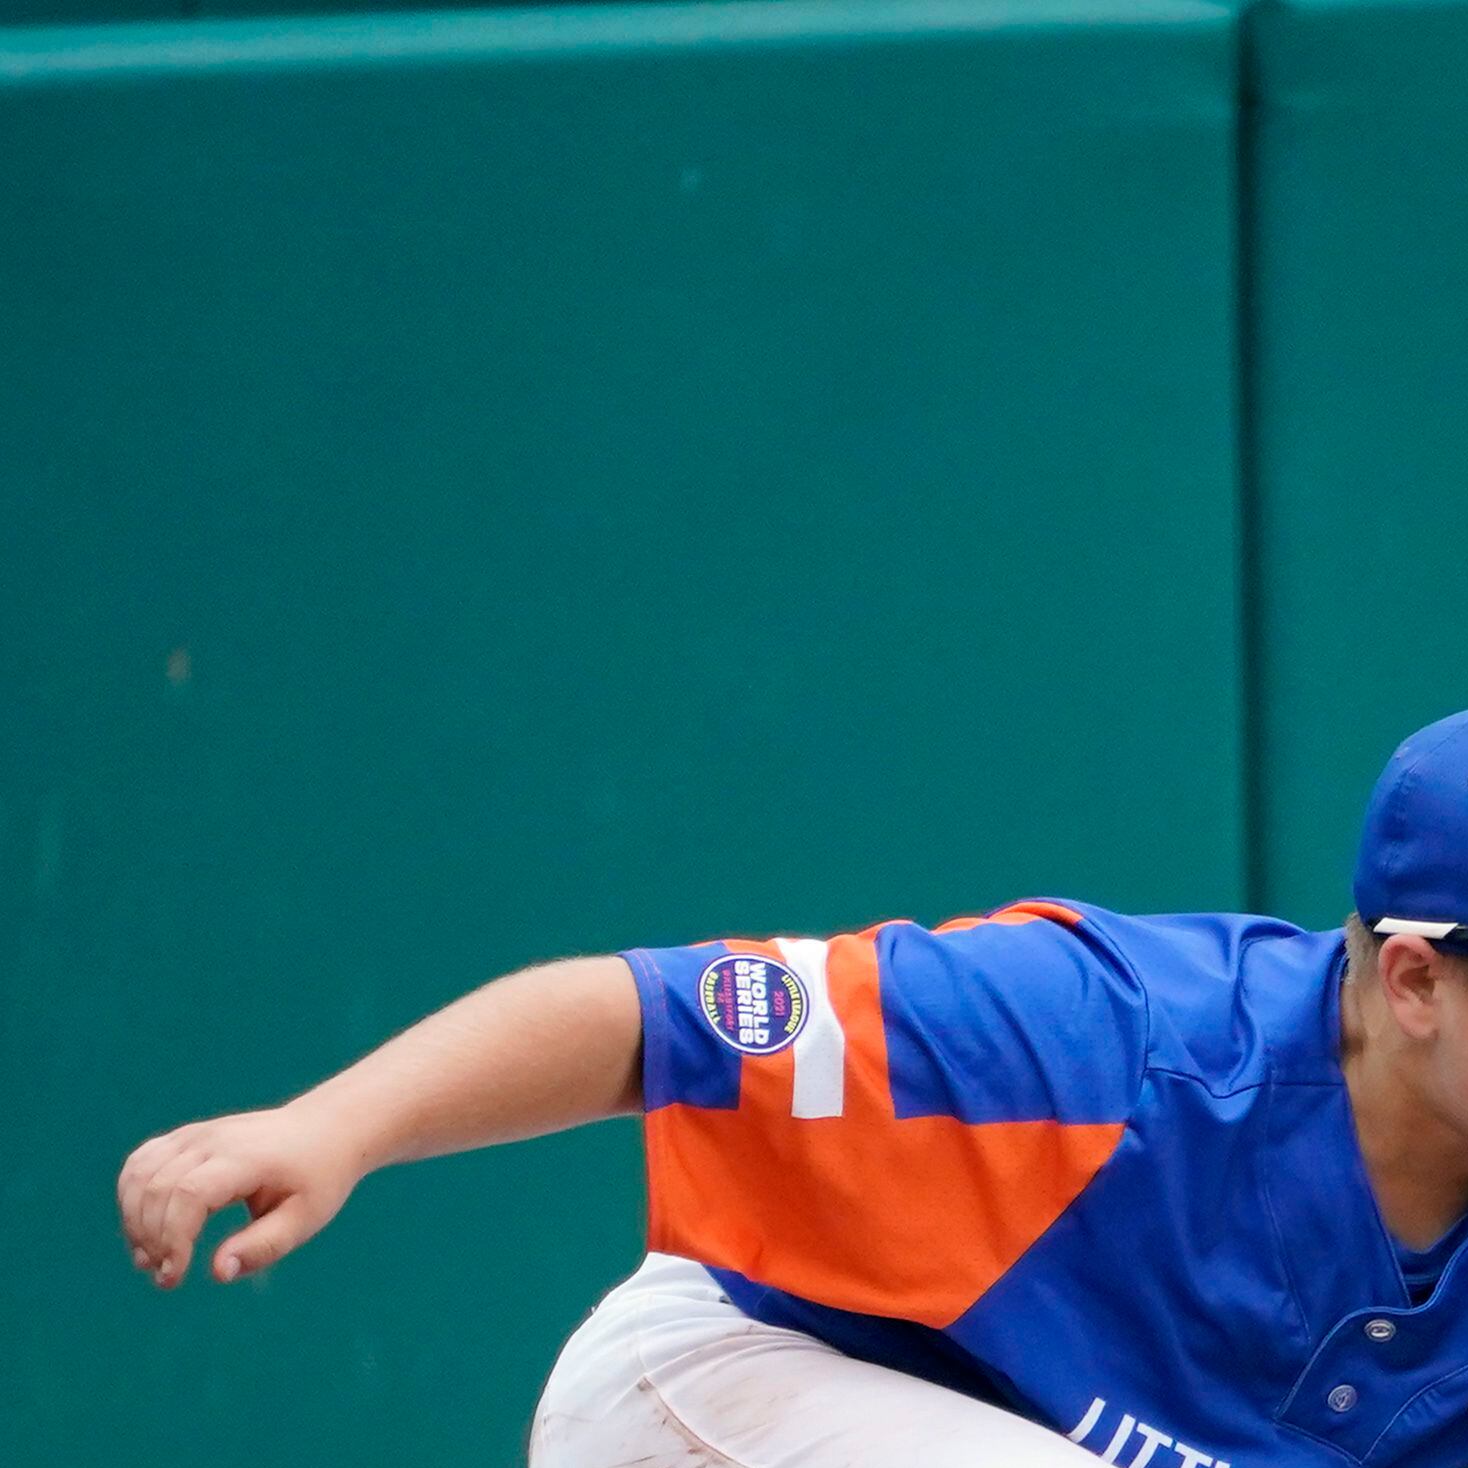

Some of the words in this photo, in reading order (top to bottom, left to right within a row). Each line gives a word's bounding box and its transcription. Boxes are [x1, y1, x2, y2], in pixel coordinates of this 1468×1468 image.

[734, 960, 754, 1044] SERIES
[750, 963, 770, 1045] WORLD
[774, 991, 785, 1016] 2021
